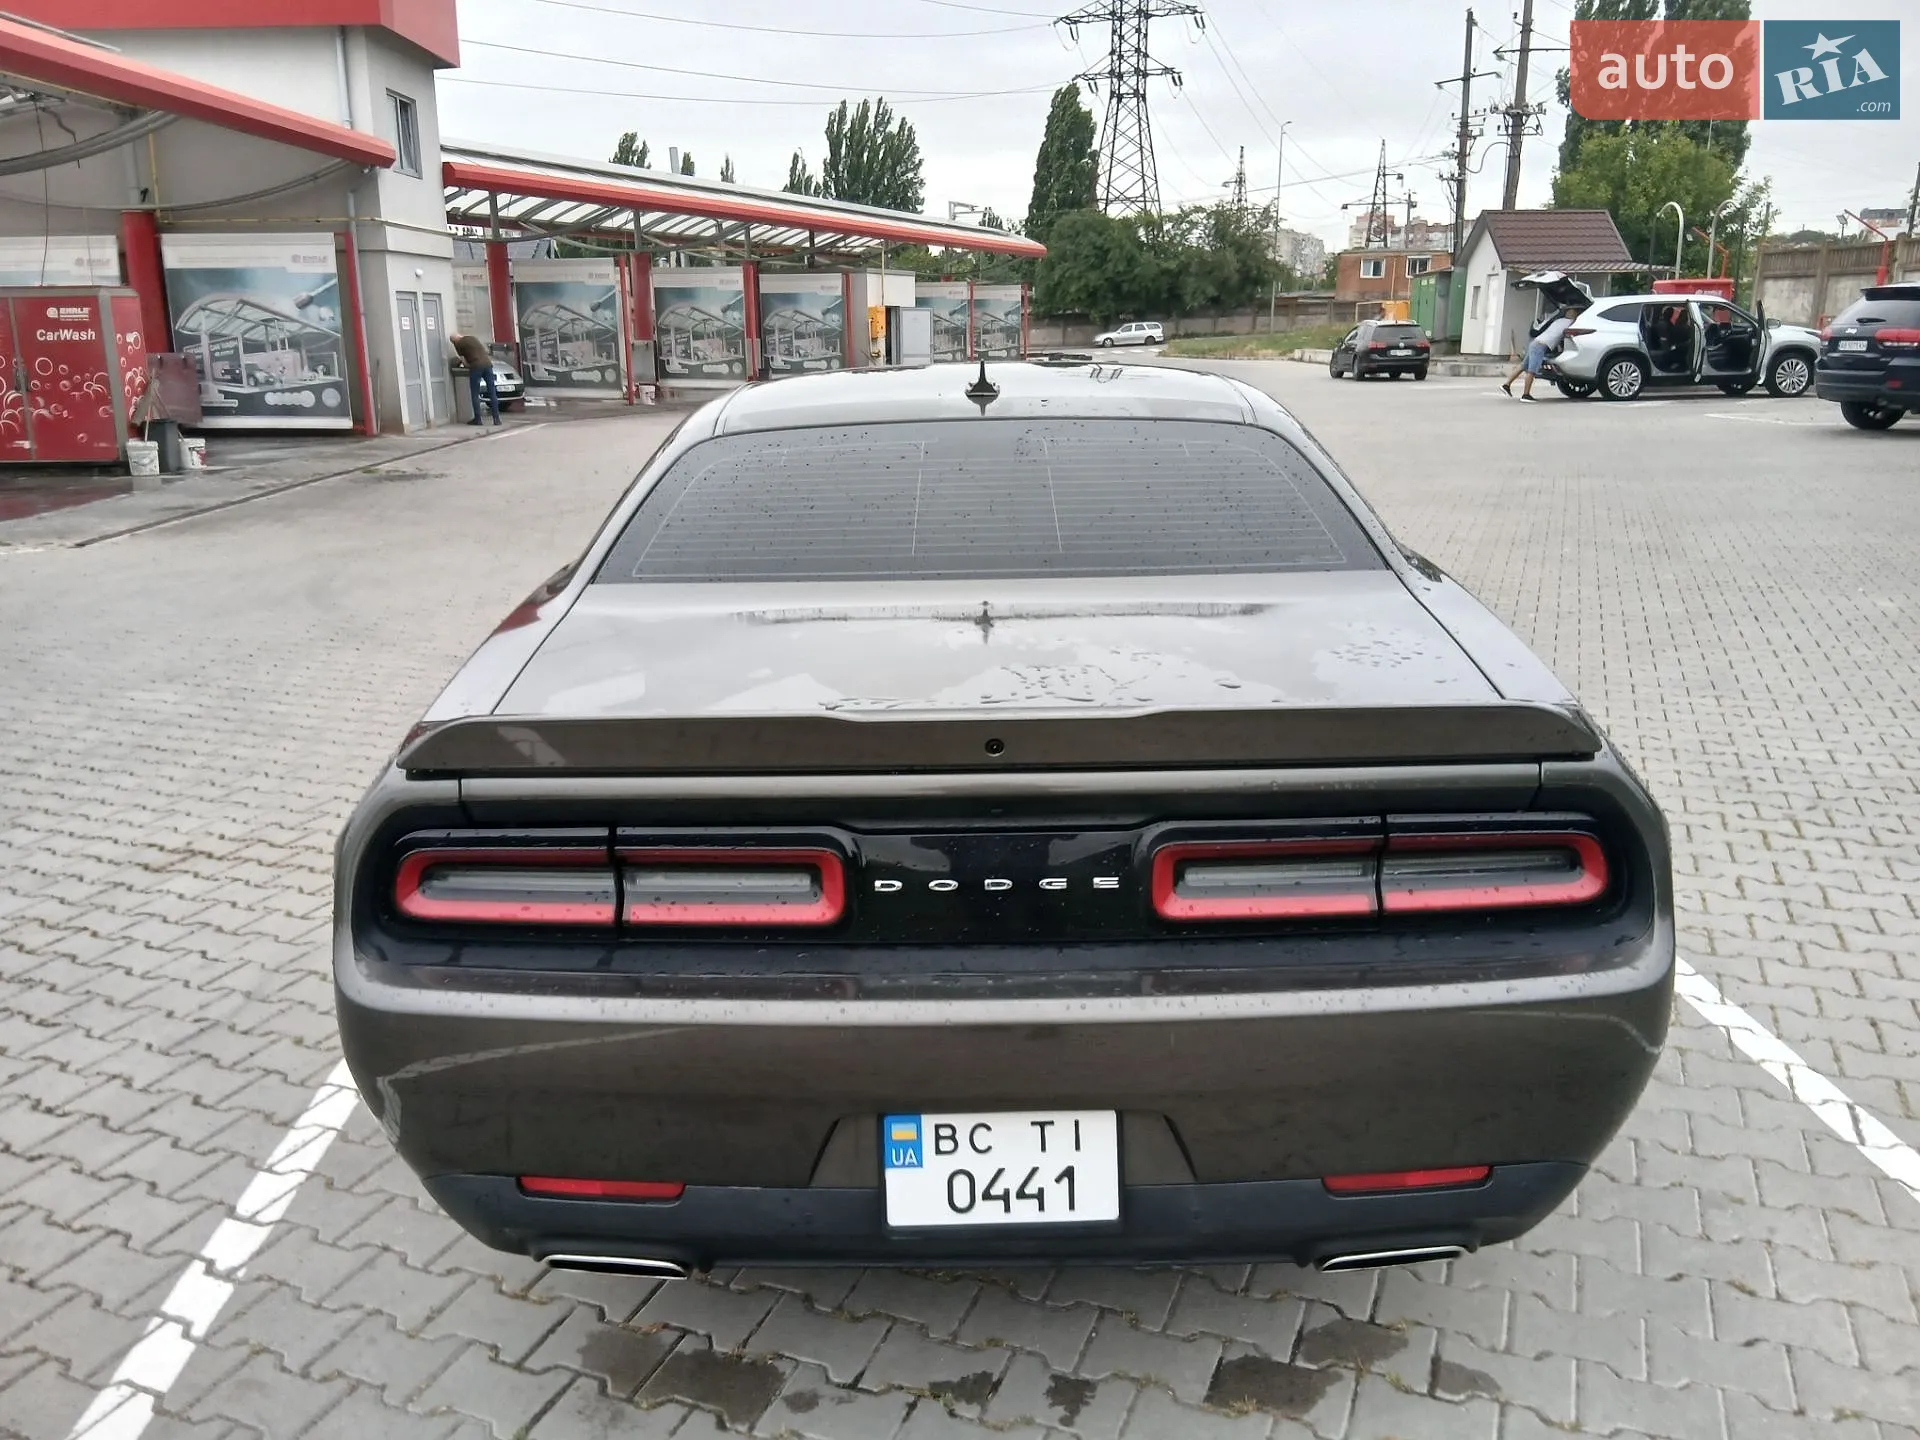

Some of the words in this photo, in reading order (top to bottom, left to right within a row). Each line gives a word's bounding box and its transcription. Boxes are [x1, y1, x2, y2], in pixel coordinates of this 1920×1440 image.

[36, 329, 96, 341] CarWash
[874, 876, 1120, 892] DODGE
[934, 1122, 993, 1155] BC
[891, 1147, 918, 1166] UA
[947, 1165, 1076, 1214] 0441
